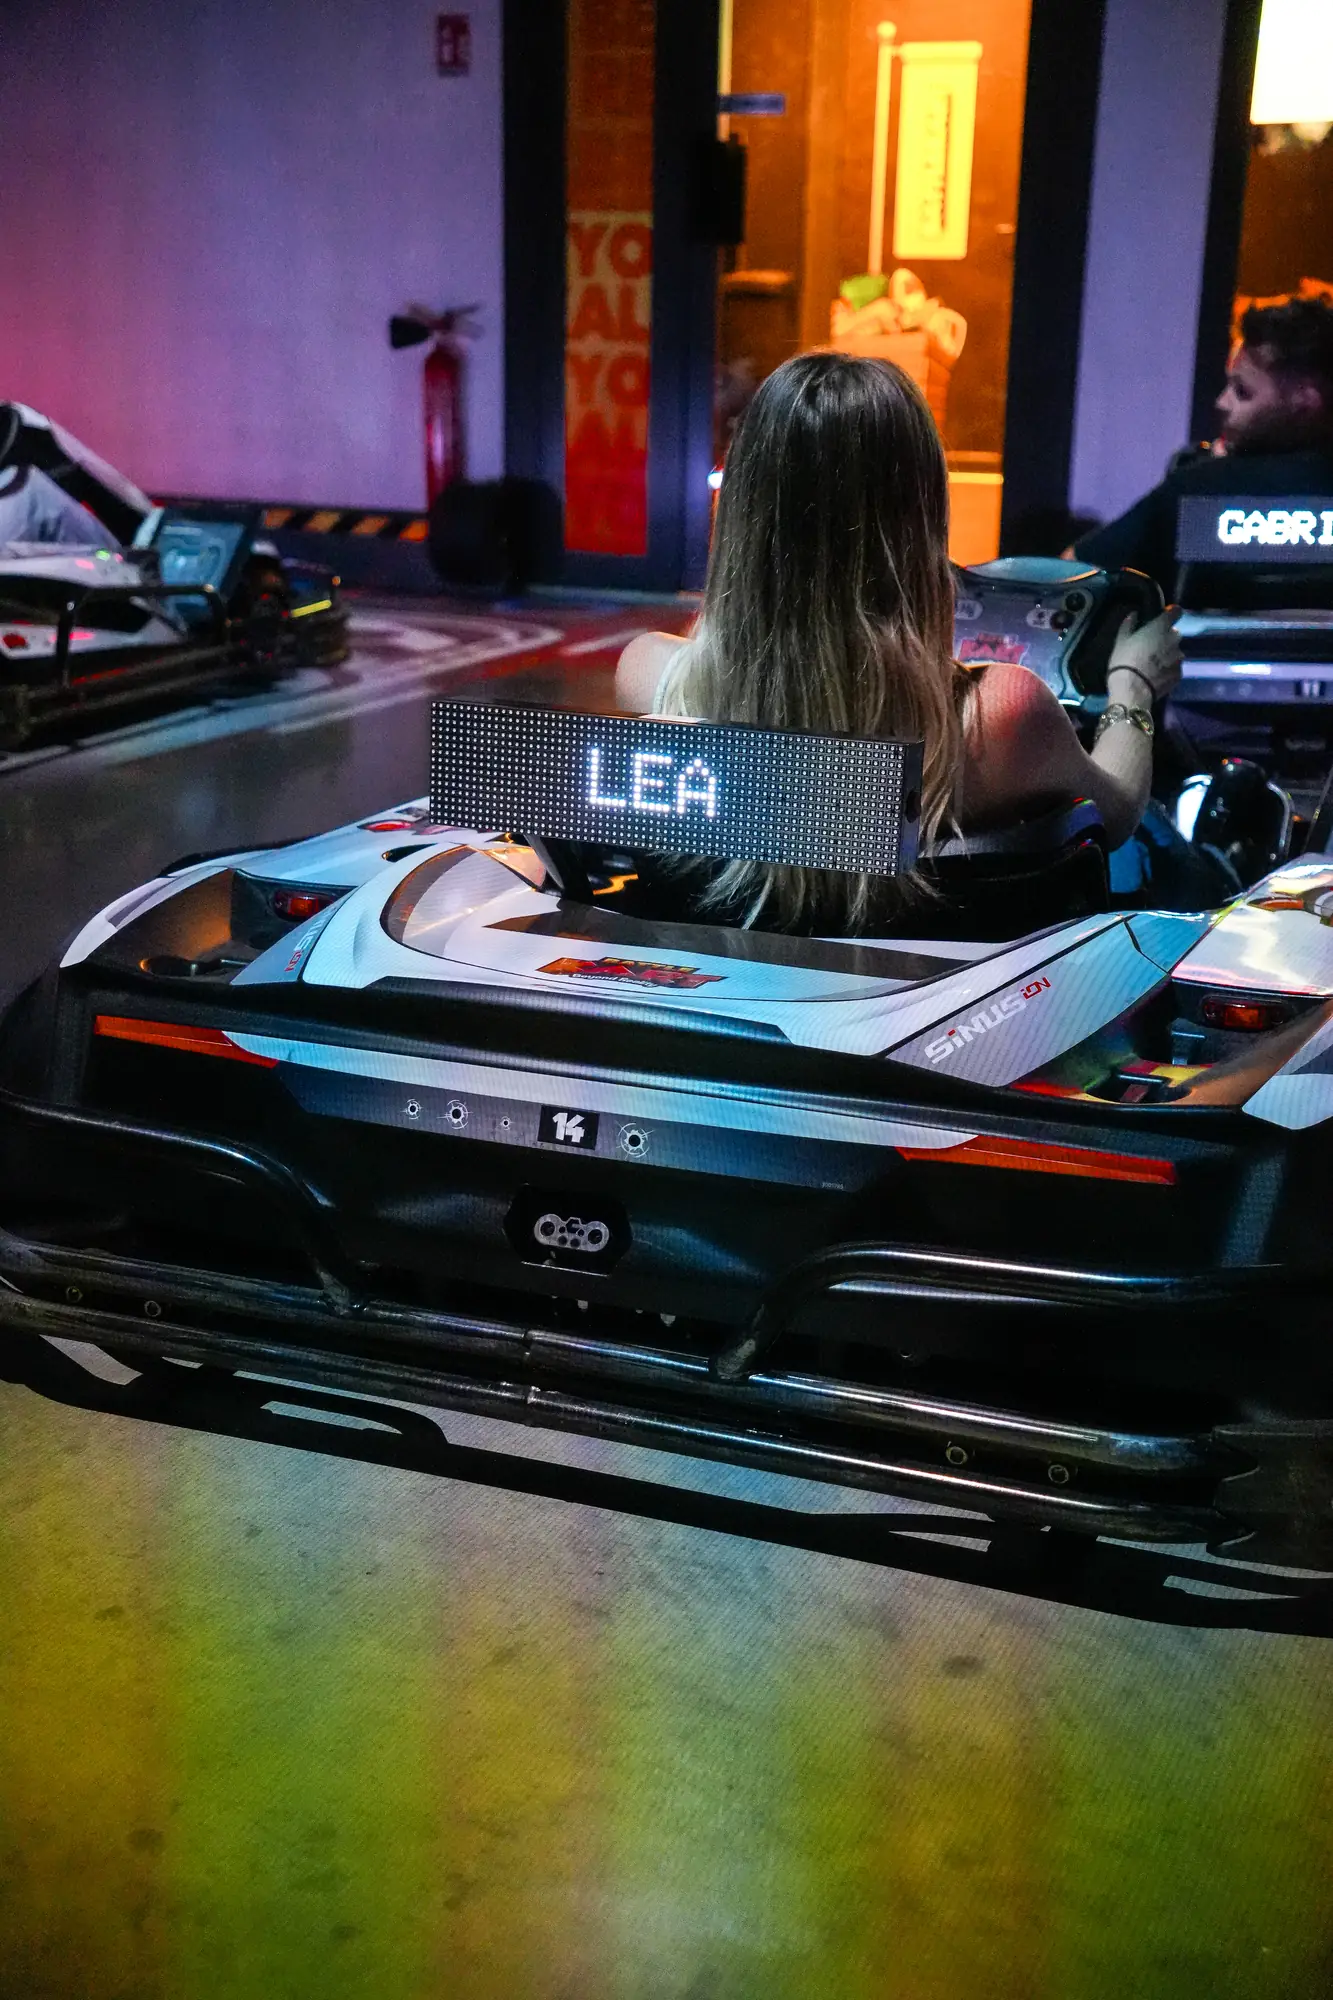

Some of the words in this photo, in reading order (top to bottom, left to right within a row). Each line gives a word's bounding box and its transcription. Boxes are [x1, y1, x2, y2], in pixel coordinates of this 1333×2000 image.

[1217, 509, 1333, 545] GABRI
[590, 747, 714, 817] LEA
[552, 1112, 586, 1143] 14
